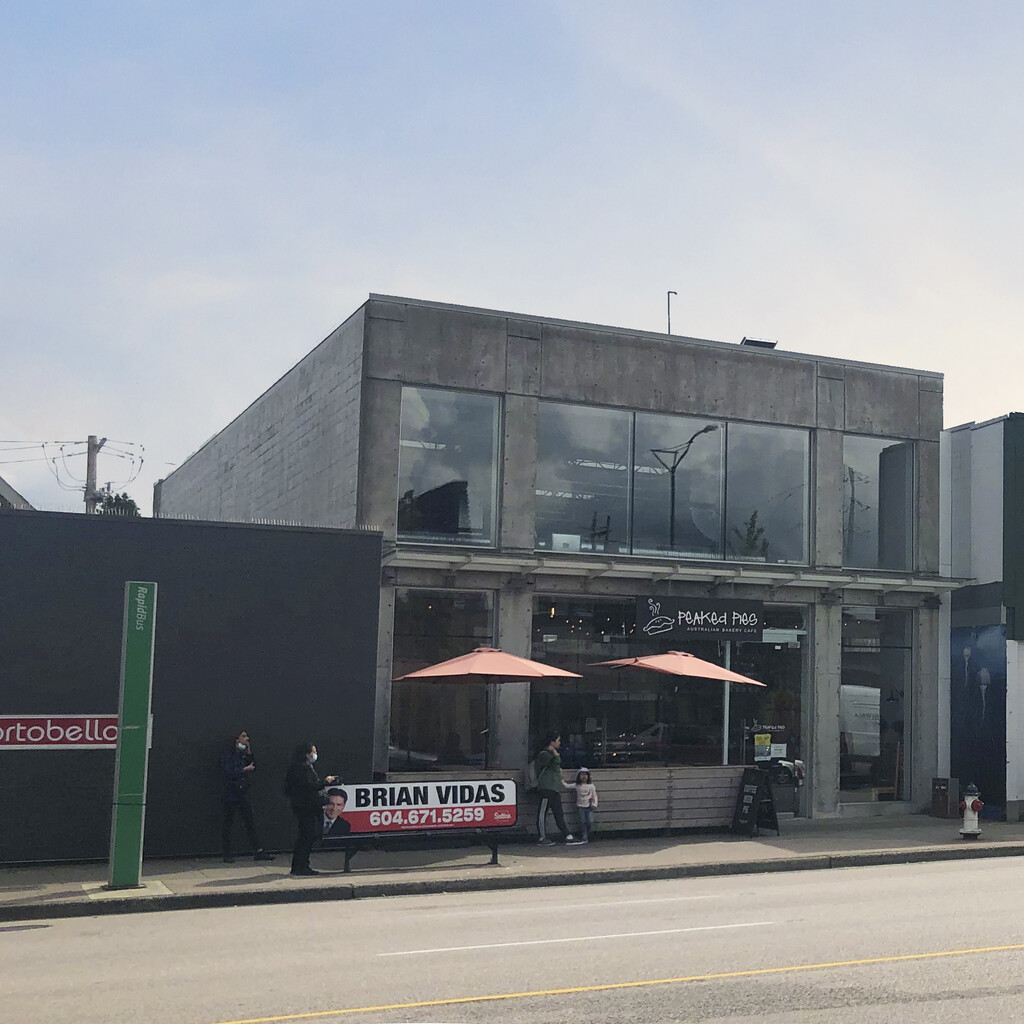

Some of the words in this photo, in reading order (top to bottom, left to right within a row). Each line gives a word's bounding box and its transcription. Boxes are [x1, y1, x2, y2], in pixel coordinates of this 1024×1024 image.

[135, 585, 148, 631] RapidBus
[0, 719, 118, 742] rtobello
[354, 785, 430, 808] BRIAN
[436, 783, 506, 805] VIDAS
[369, 807, 485, 826] 604.671.5259
